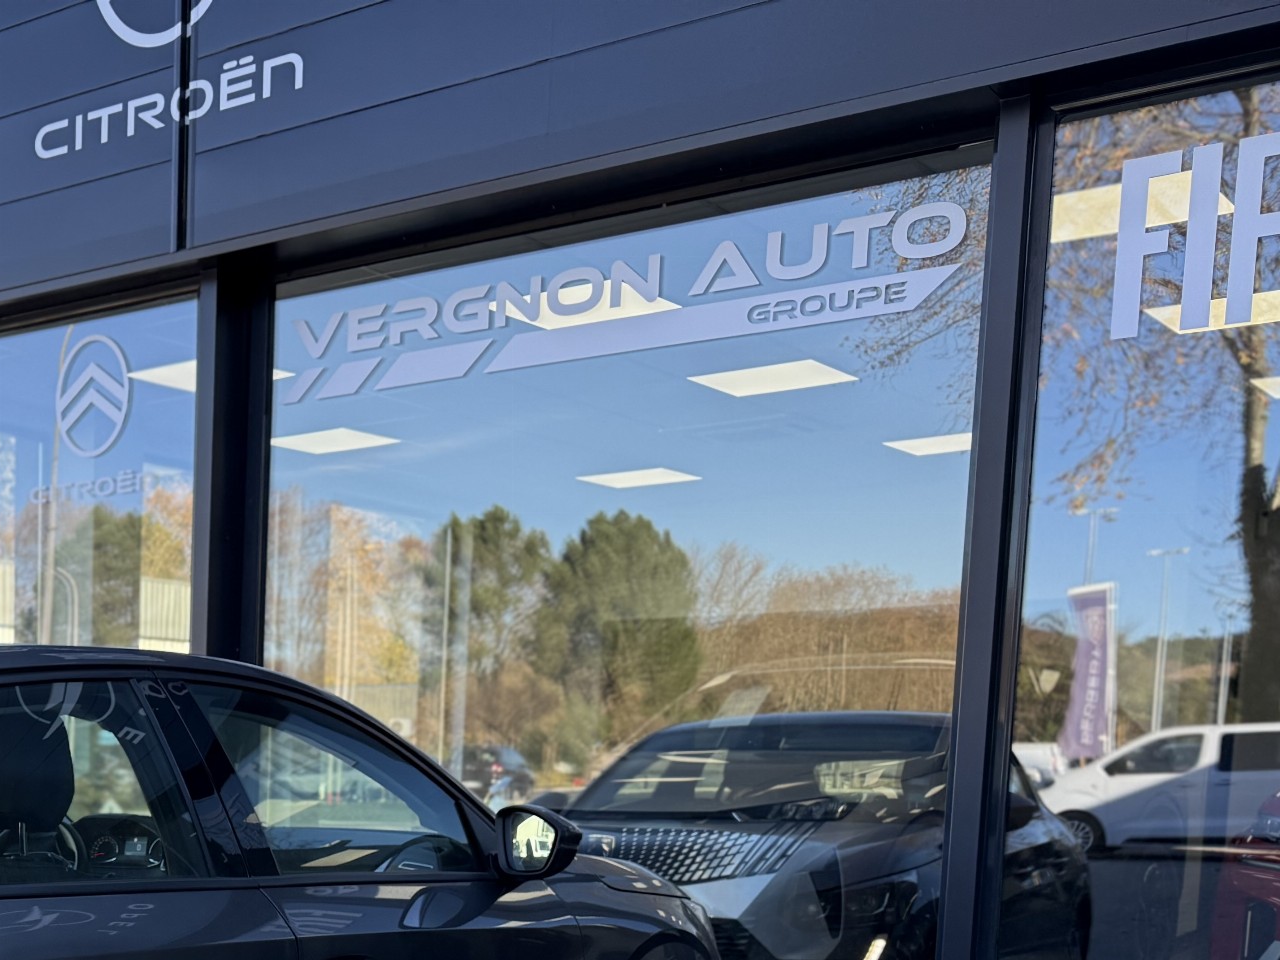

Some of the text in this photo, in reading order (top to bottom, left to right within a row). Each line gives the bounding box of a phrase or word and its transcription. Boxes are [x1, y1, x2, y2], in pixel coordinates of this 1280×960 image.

[293, 201, 968, 360] VERGNON AUTO
[746, 280, 909, 325] GROUPE
